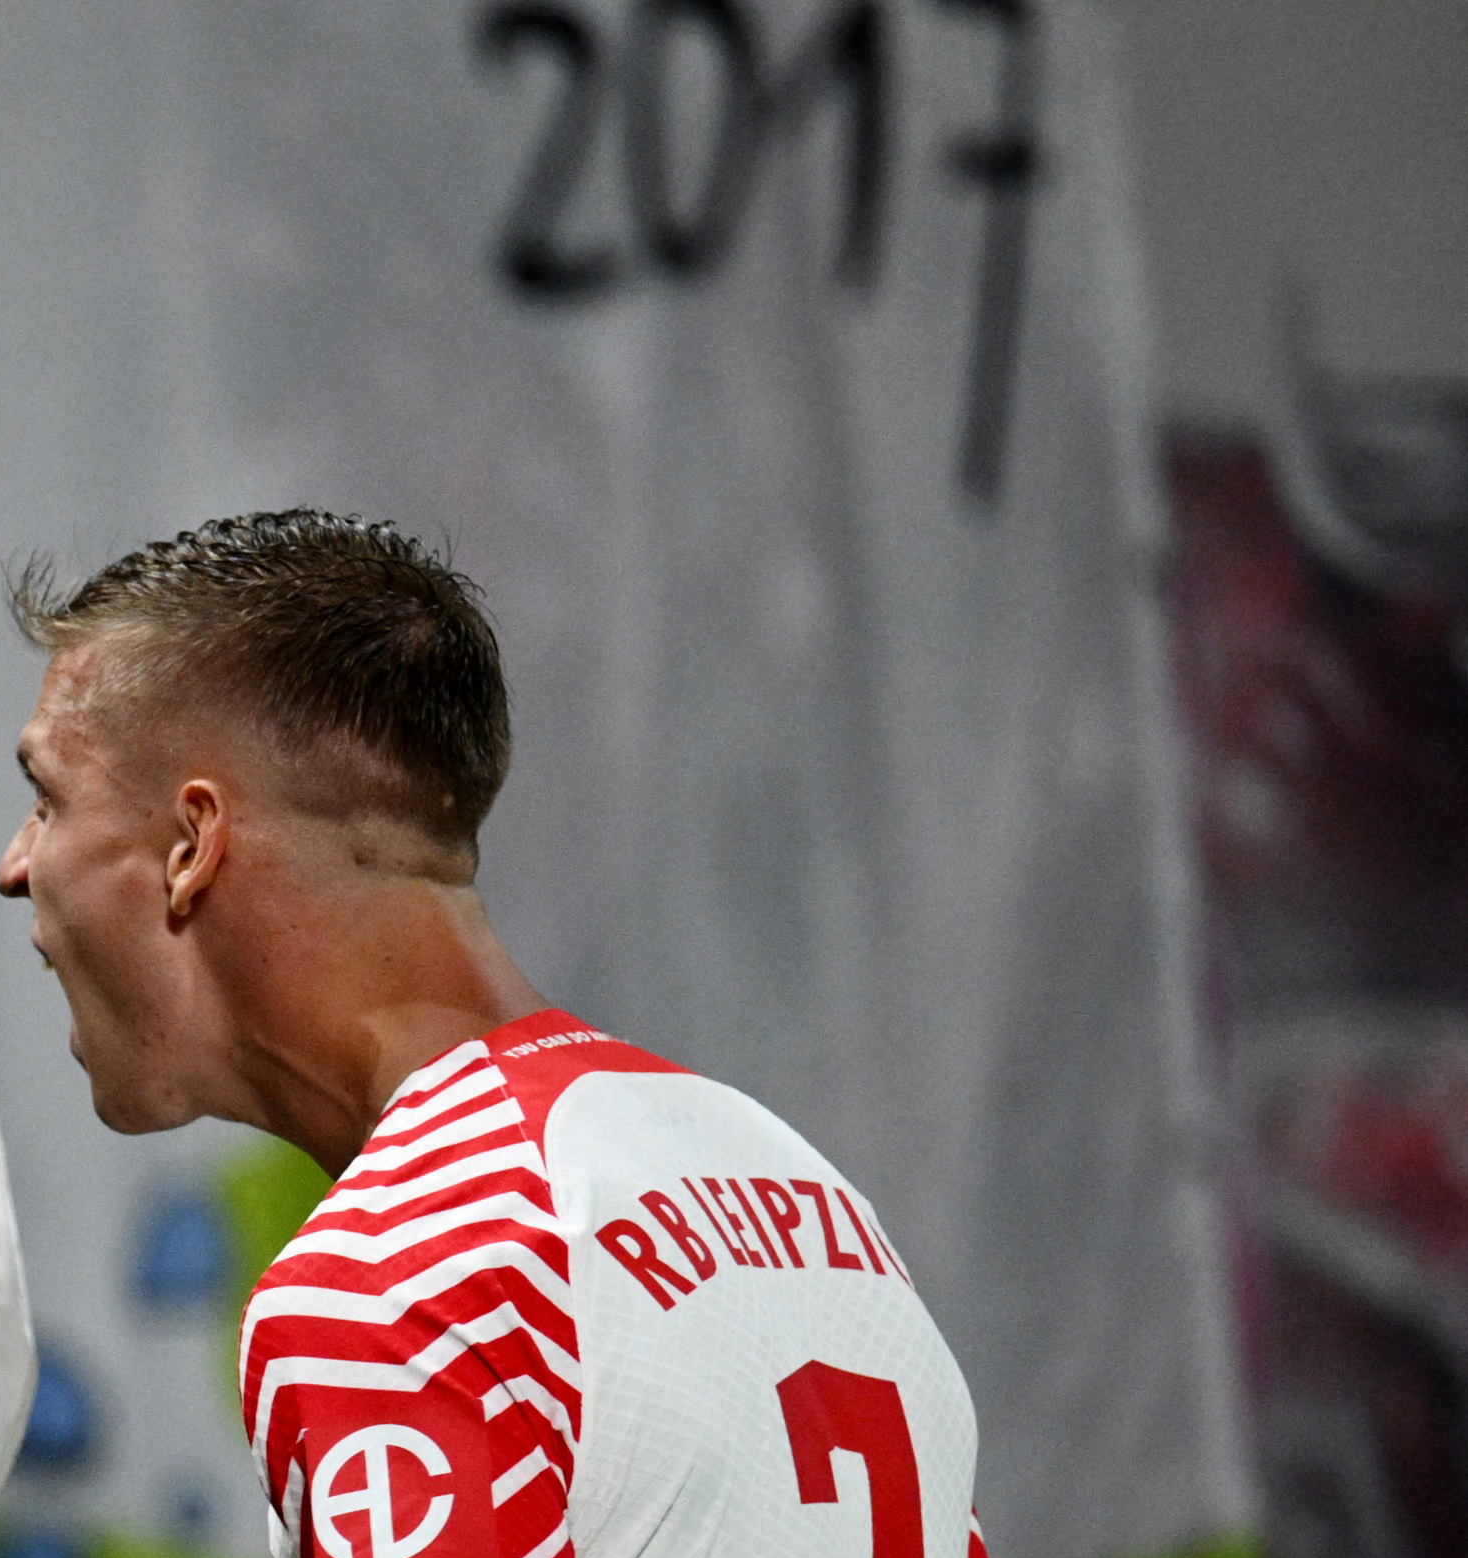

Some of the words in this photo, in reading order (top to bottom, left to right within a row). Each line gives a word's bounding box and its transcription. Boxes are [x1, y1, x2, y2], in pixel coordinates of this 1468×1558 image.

[477, 0, 1039, 512] 2017
[501, 1041, 540, 1059] YOU
[536, 1033, 572, 1049] CAN
[594, 1189, 717, 1311] RB
[680, 1176, 914, 1291] LEIPZI
